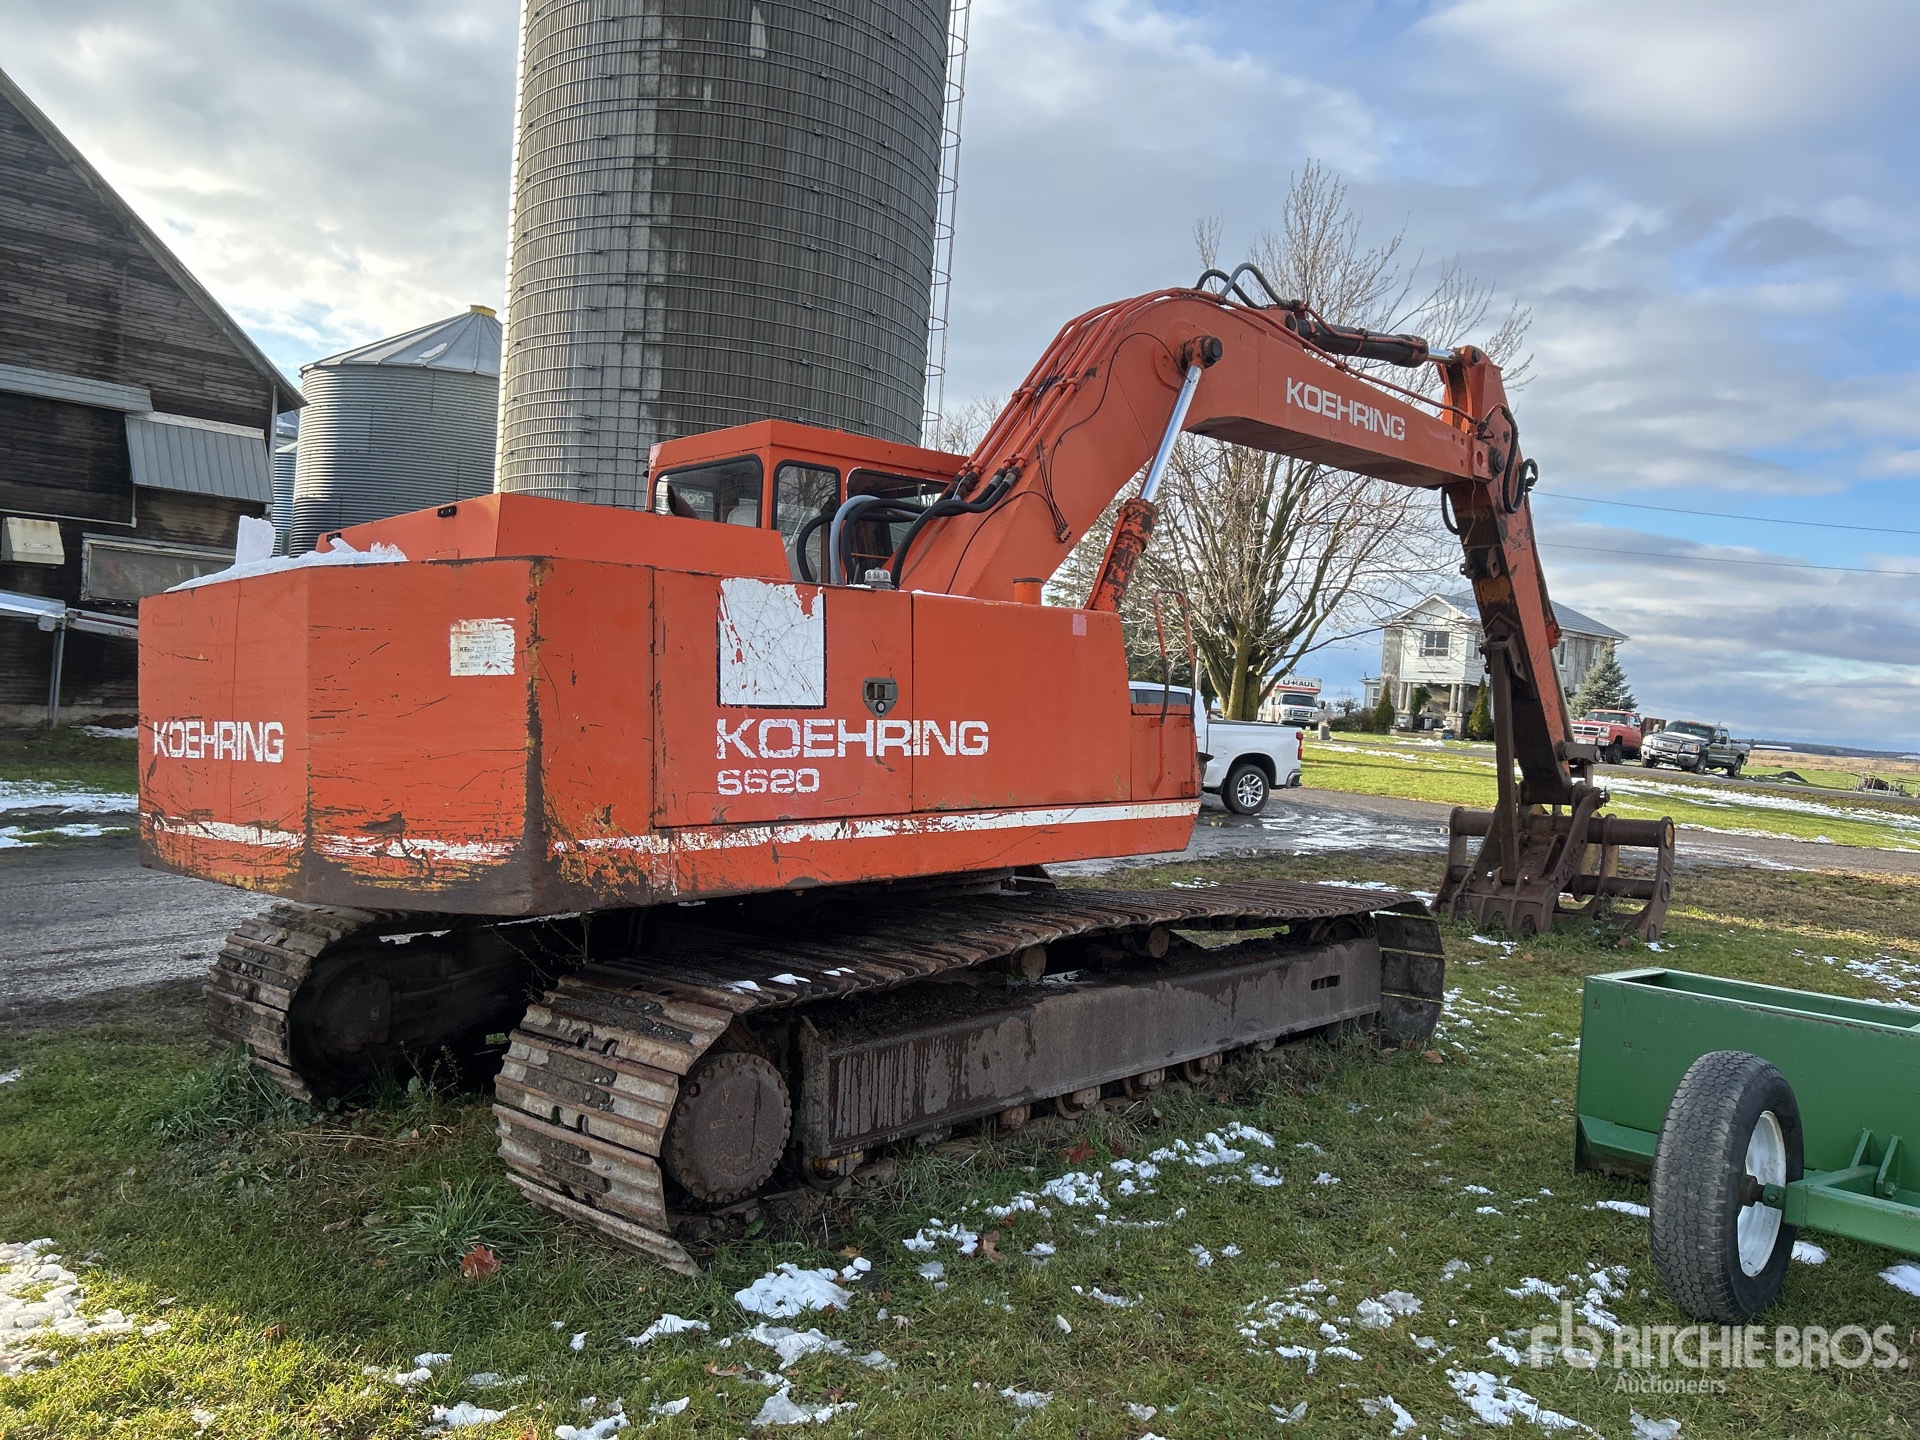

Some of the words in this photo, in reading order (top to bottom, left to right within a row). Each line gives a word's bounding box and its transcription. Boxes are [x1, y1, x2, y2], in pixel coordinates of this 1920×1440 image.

[1287, 377, 1405, 441] KOEHRING
[153, 720, 284, 763] KOEHRING
[716, 718, 989, 759] KOEHRING
